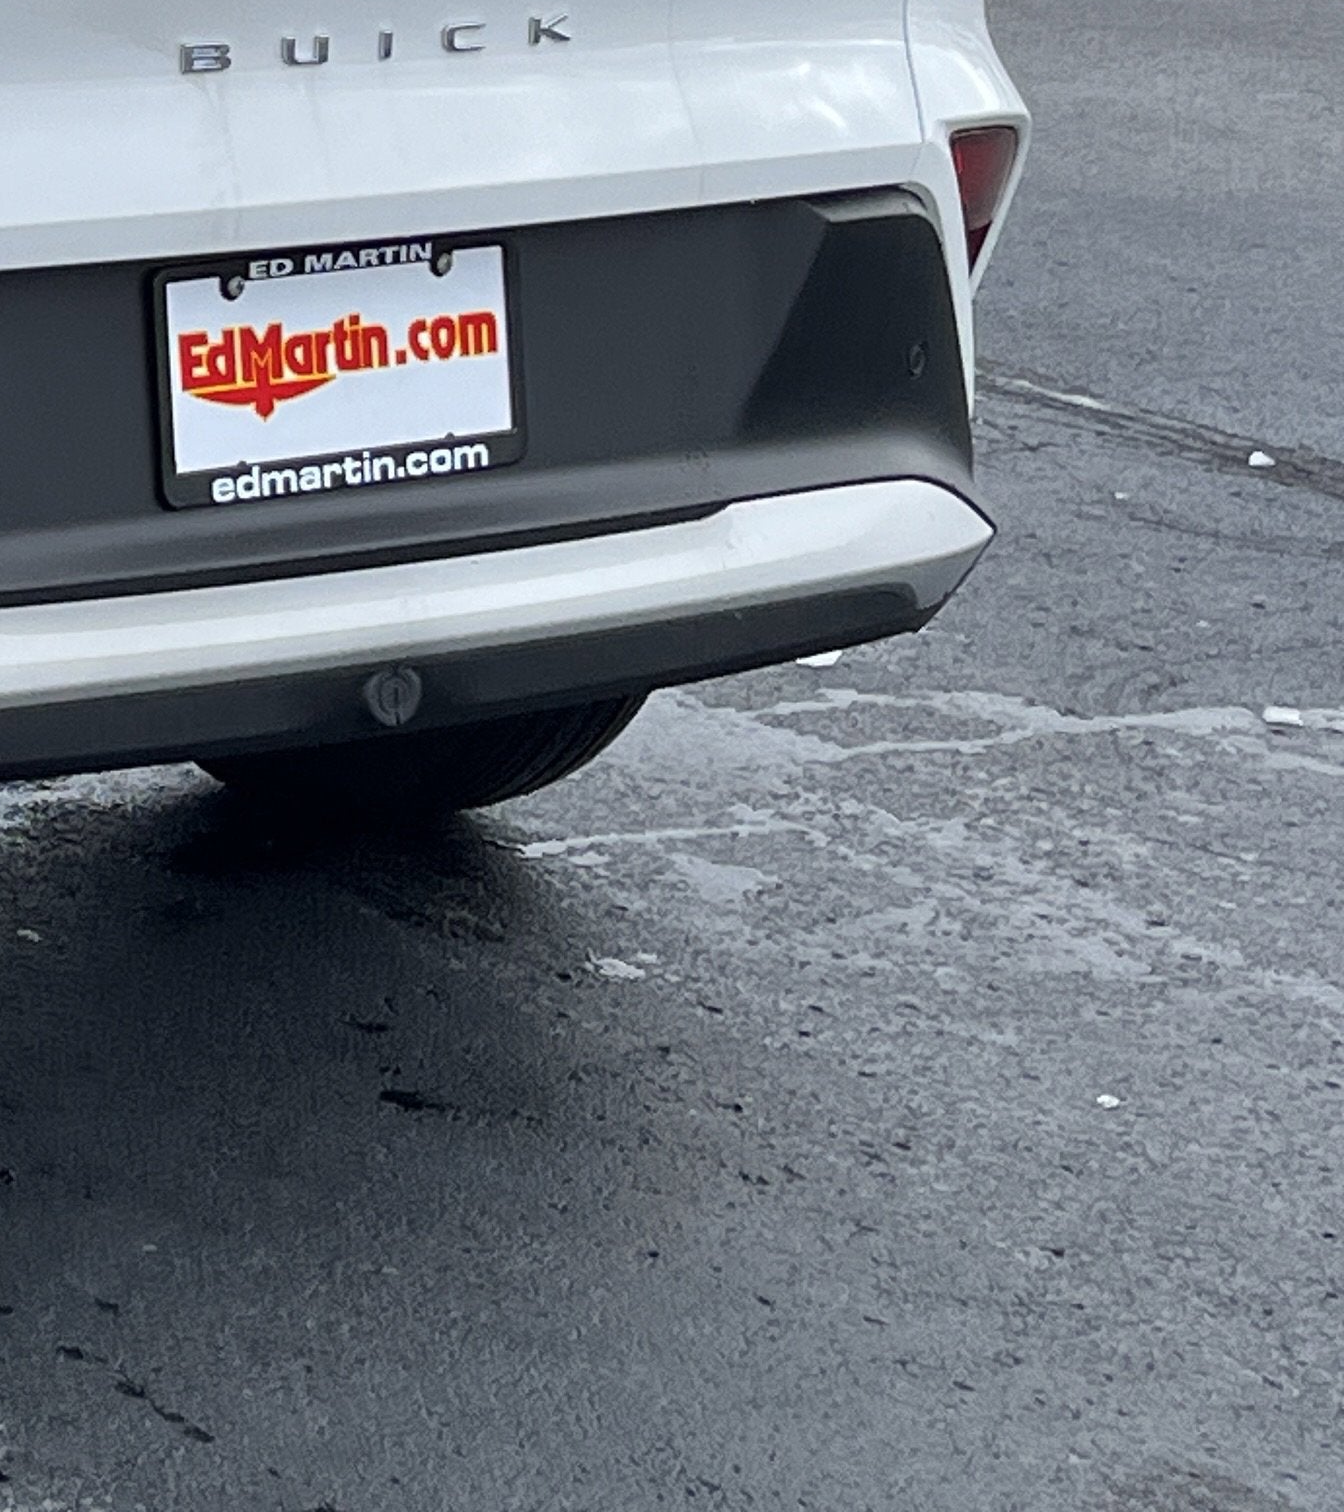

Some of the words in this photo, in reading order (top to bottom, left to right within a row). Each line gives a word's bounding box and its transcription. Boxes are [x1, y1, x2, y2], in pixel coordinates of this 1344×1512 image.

[180, 12, 571, 74] BUICK
[248, 257, 294, 280] ED
[304, 241, 433, 273] MARTIN
[177, 310, 499, 393] EdMartin.com
[211, 441, 490, 505] edmartin.com
